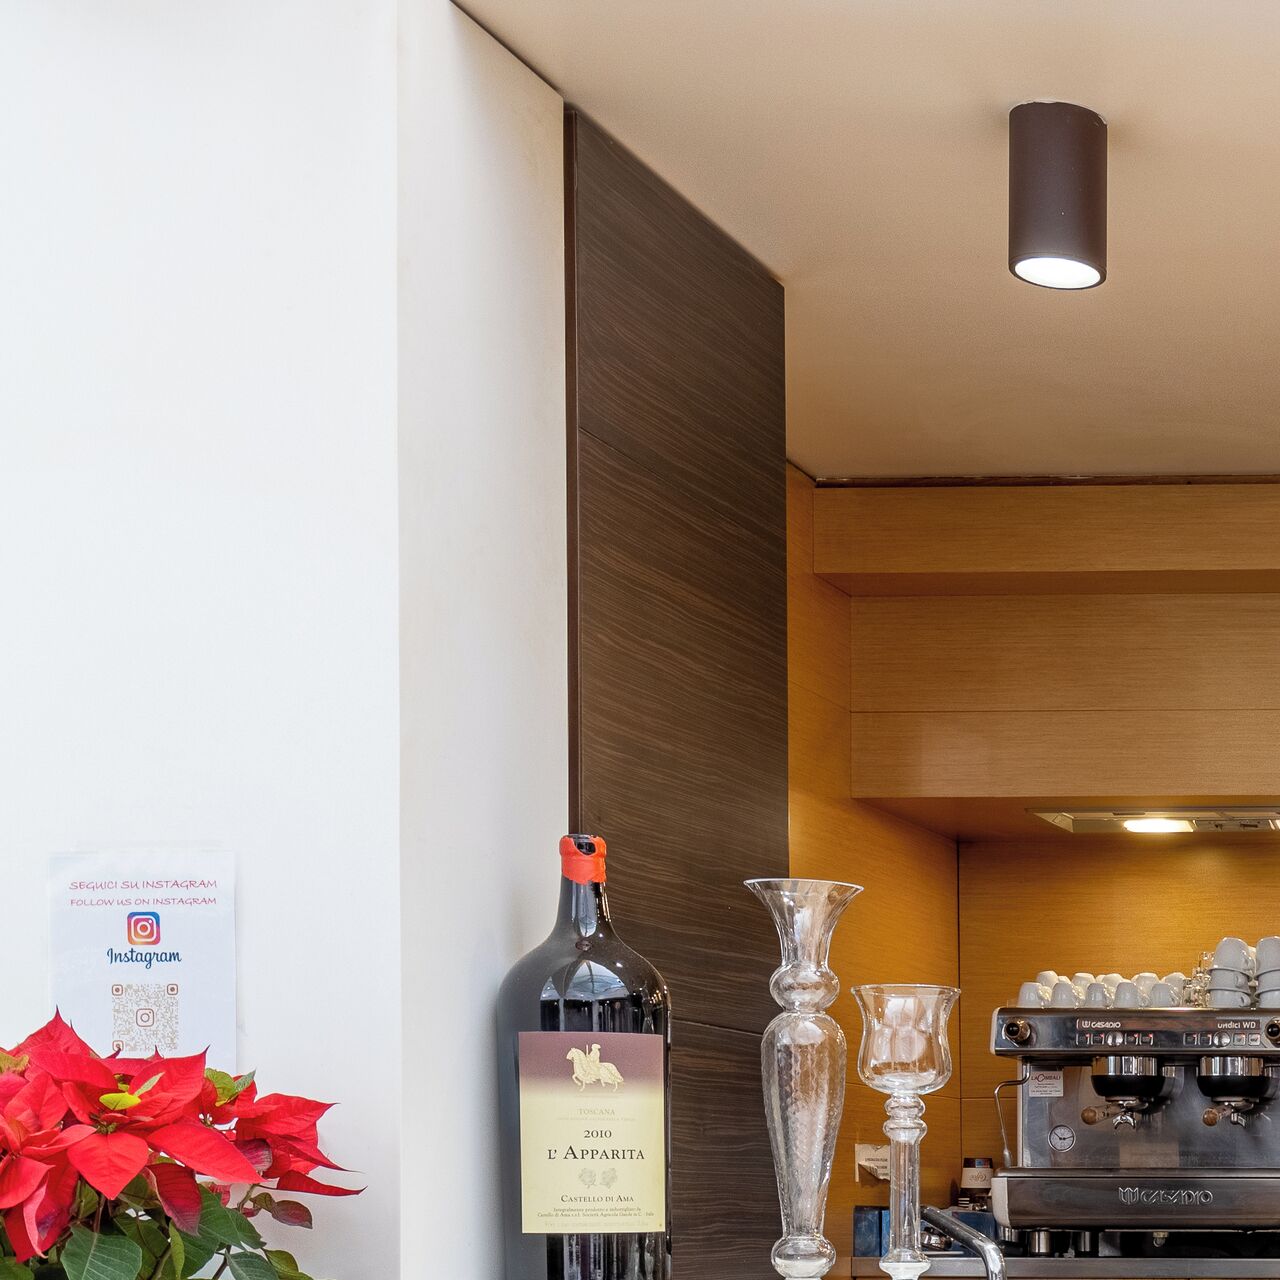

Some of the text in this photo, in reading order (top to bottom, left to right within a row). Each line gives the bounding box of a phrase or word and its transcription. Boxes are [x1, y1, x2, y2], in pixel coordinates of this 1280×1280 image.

[69, 880, 218, 891] SEGUICI SU INSTAGRAM
[153, 898, 217, 906] INSTAGRAM
[107, 948, 182, 969] Instagram
[1092, 1021, 1121, 1029] CASADIO
[1243, 1021, 1256, 1029] WD
[577, 1108, 615, 1116] TOSCANA
[584, 1130, 612, 1139] 2010
[563, 1145, 645, 1160] APPARITA
[561, 1194, 603, 1203] CASTELLO
[616, 1194, 634, 1203] AMA
